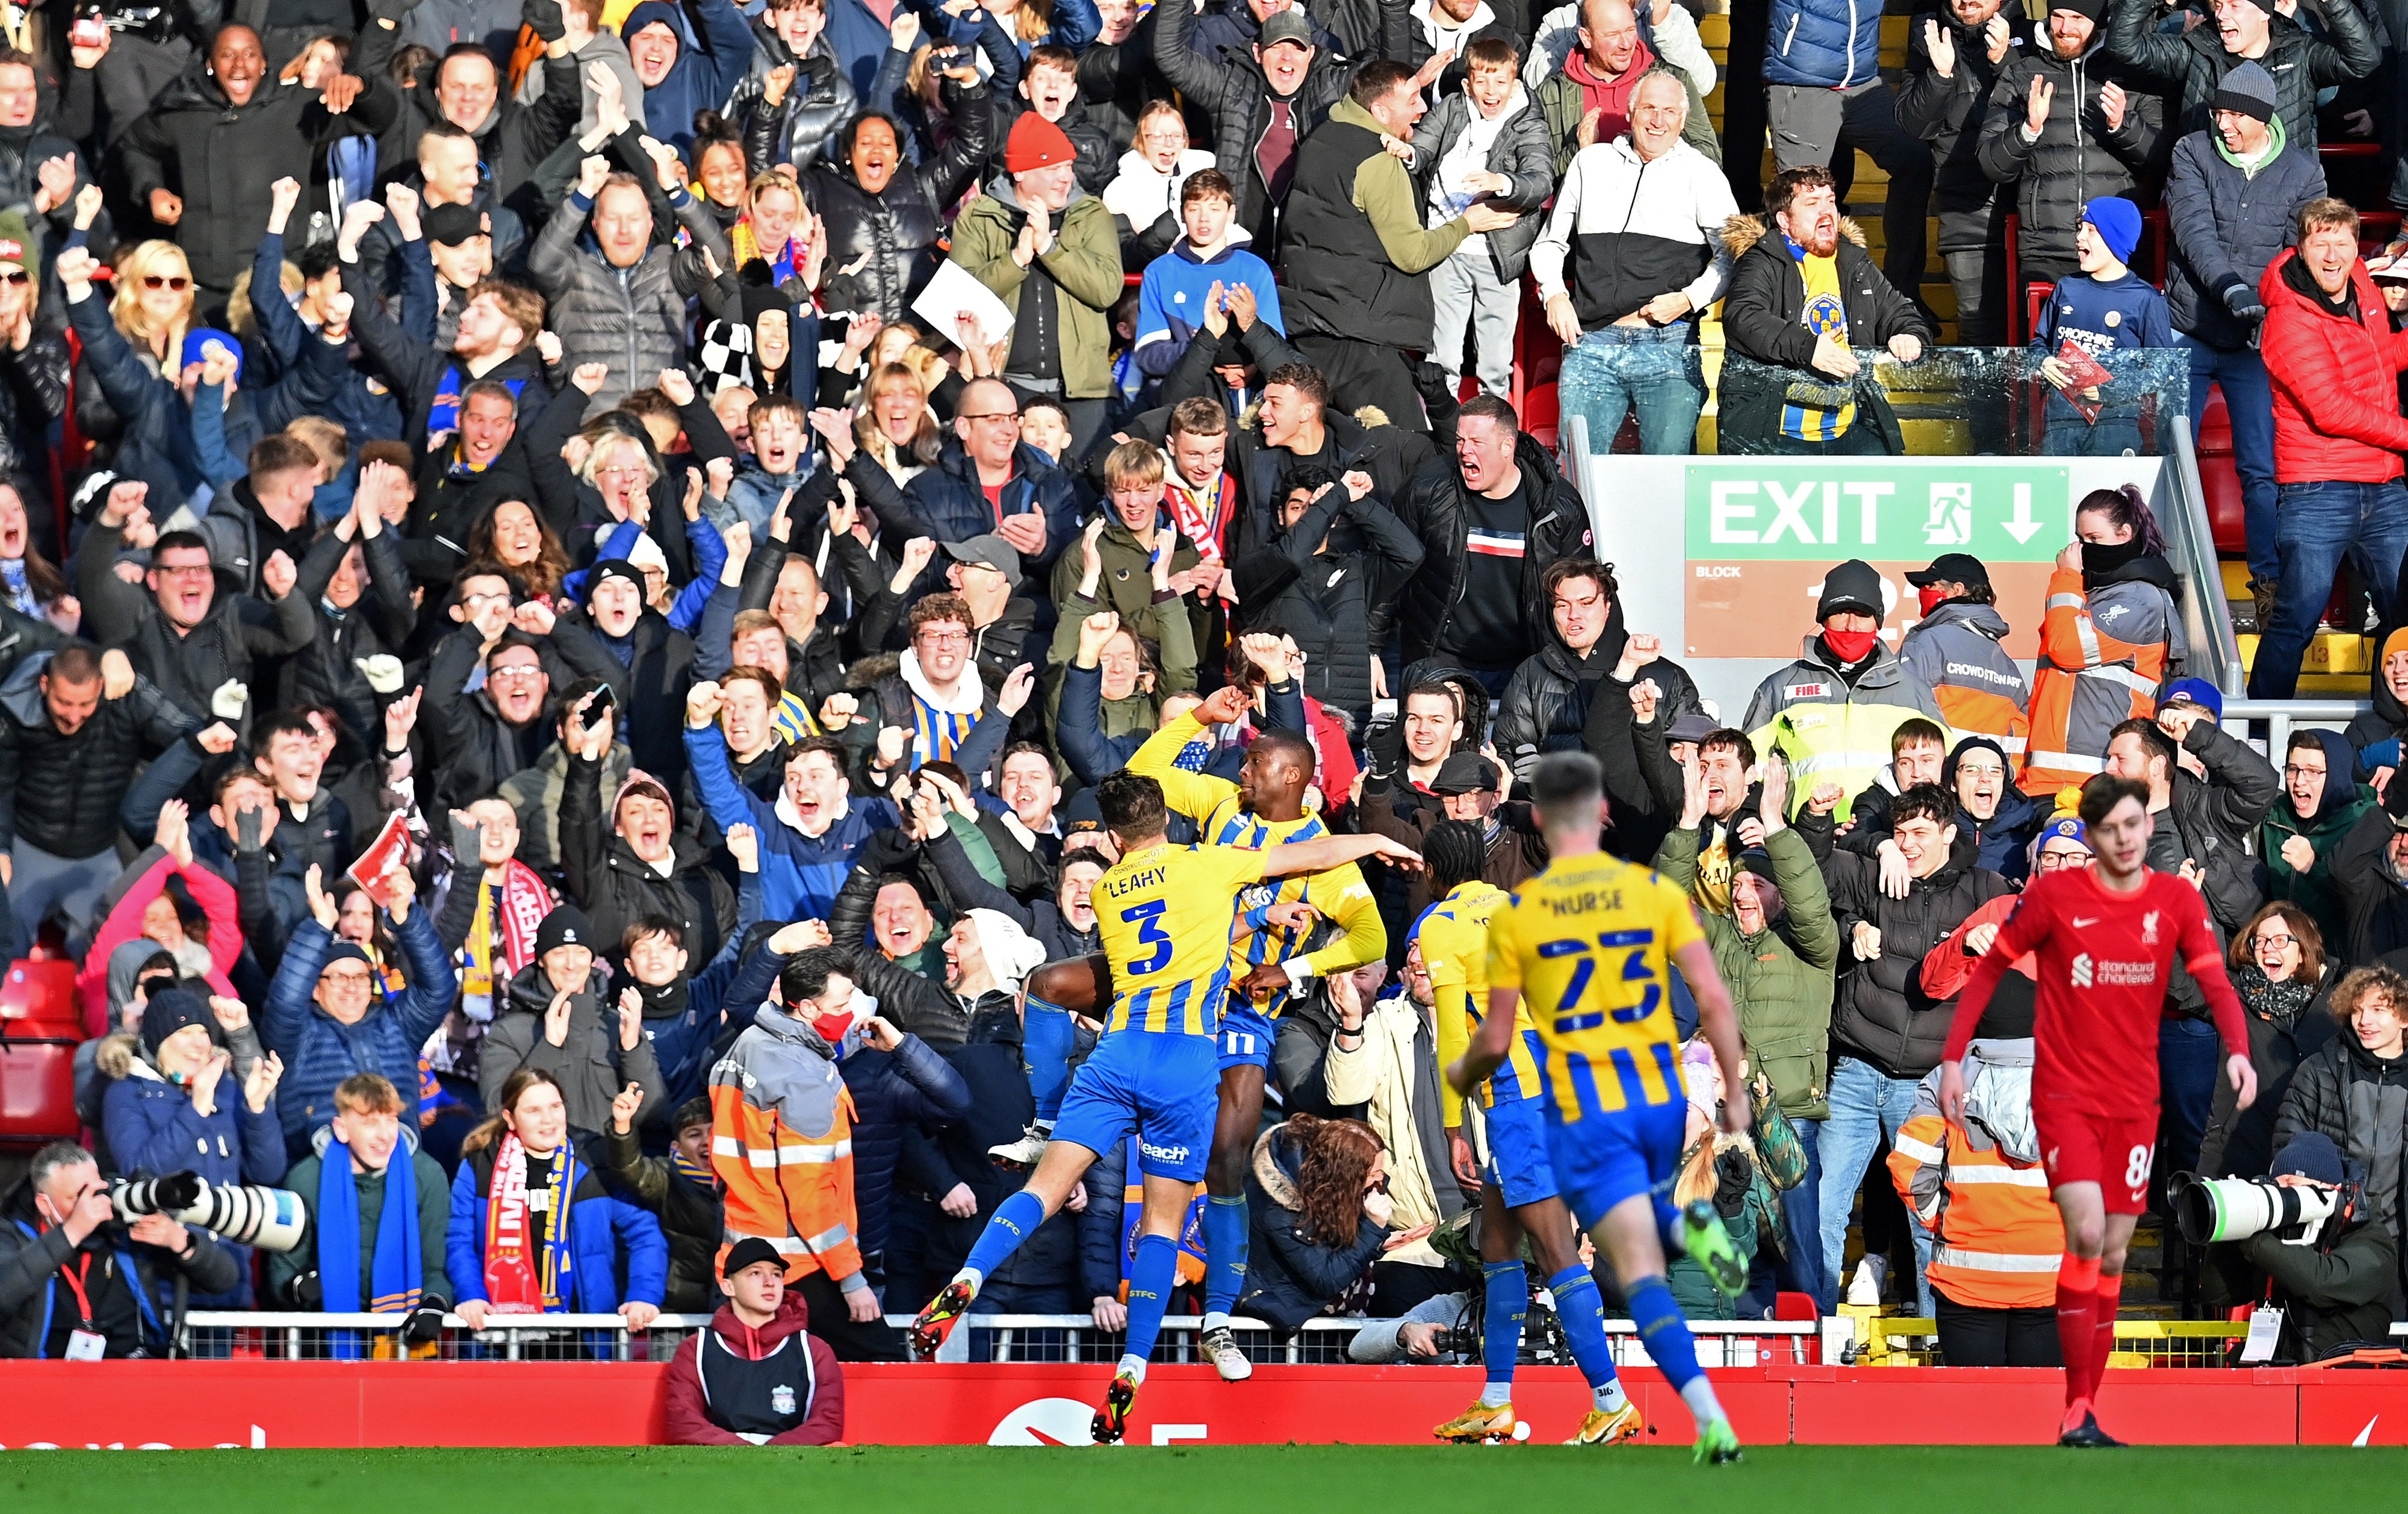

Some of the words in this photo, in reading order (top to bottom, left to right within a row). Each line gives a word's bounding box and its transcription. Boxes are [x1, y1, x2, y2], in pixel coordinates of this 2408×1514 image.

[1710, 480, 1895, 544] EXIT
[1696, 566, 1741, 577] BLOCK
[2312, 645, 2329, 663] 13
[1946, 662, 1984, 678] CROWD
[1795, 684, 1821, 696] FIRE
[1109, 866, 1166, 898] LEAHY
[1551, 888, 1624, 918] NURSE
[1120, 898, 1173, 976] 3
[2098, 960, 2155, 972] standard
[1537, 928, 1662, 1035] 23
[2097, 973, 2154, 984] chartered
[994, 1217, 1020, 1236] STFC
[1129, 1289, 1158, 1300] STFC
